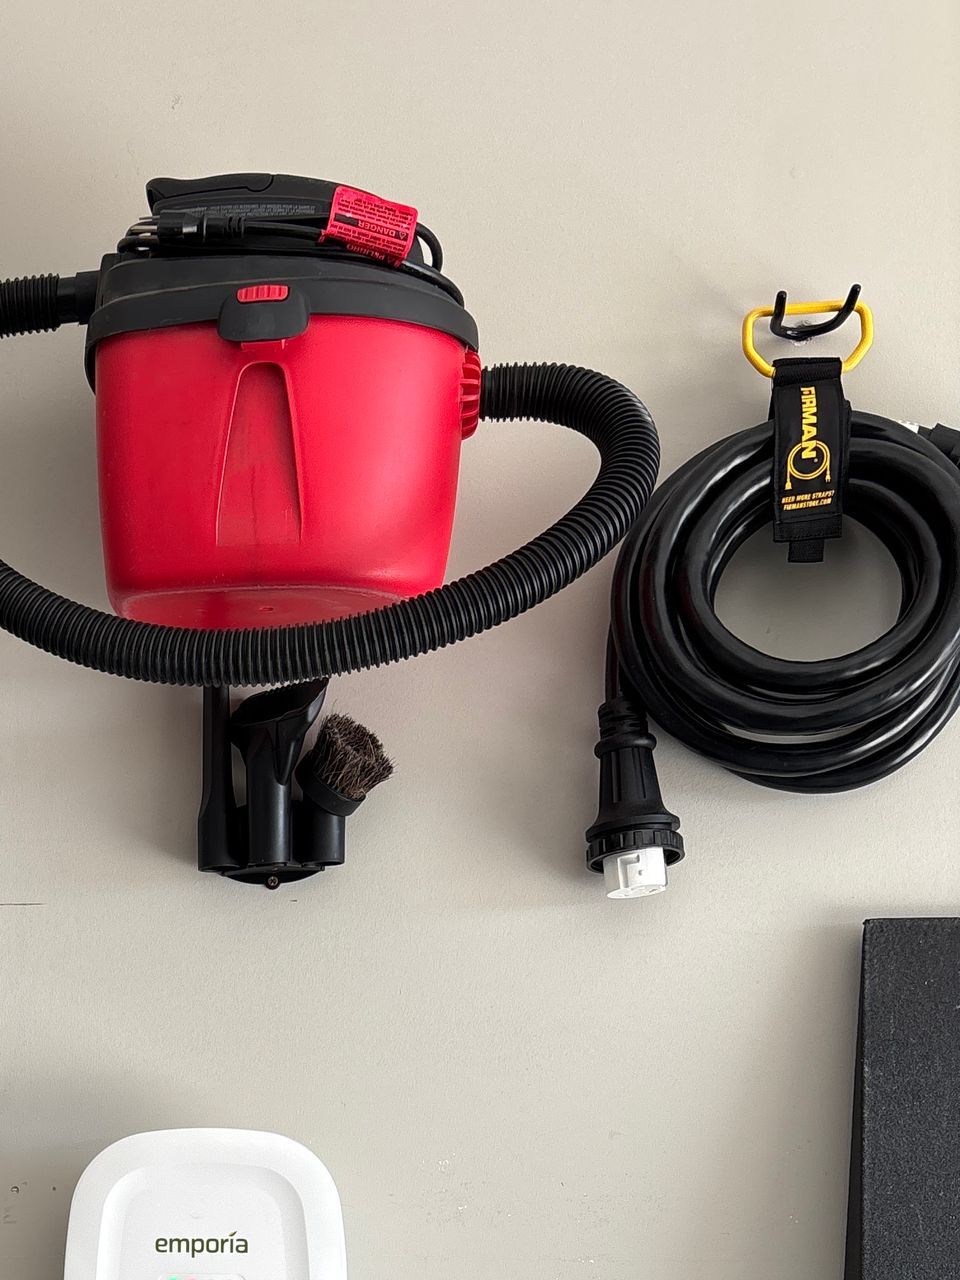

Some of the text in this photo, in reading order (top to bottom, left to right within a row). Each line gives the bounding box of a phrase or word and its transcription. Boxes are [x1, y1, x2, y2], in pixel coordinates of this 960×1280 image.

[358, 219, 396, 237] DANGER
[800, 386, 817, 459] FIRMAN
[781, 490, 835, 504] NEED MORE STRAPS?
[783, 497, 832, 511] FIRMANSTORE.COM
